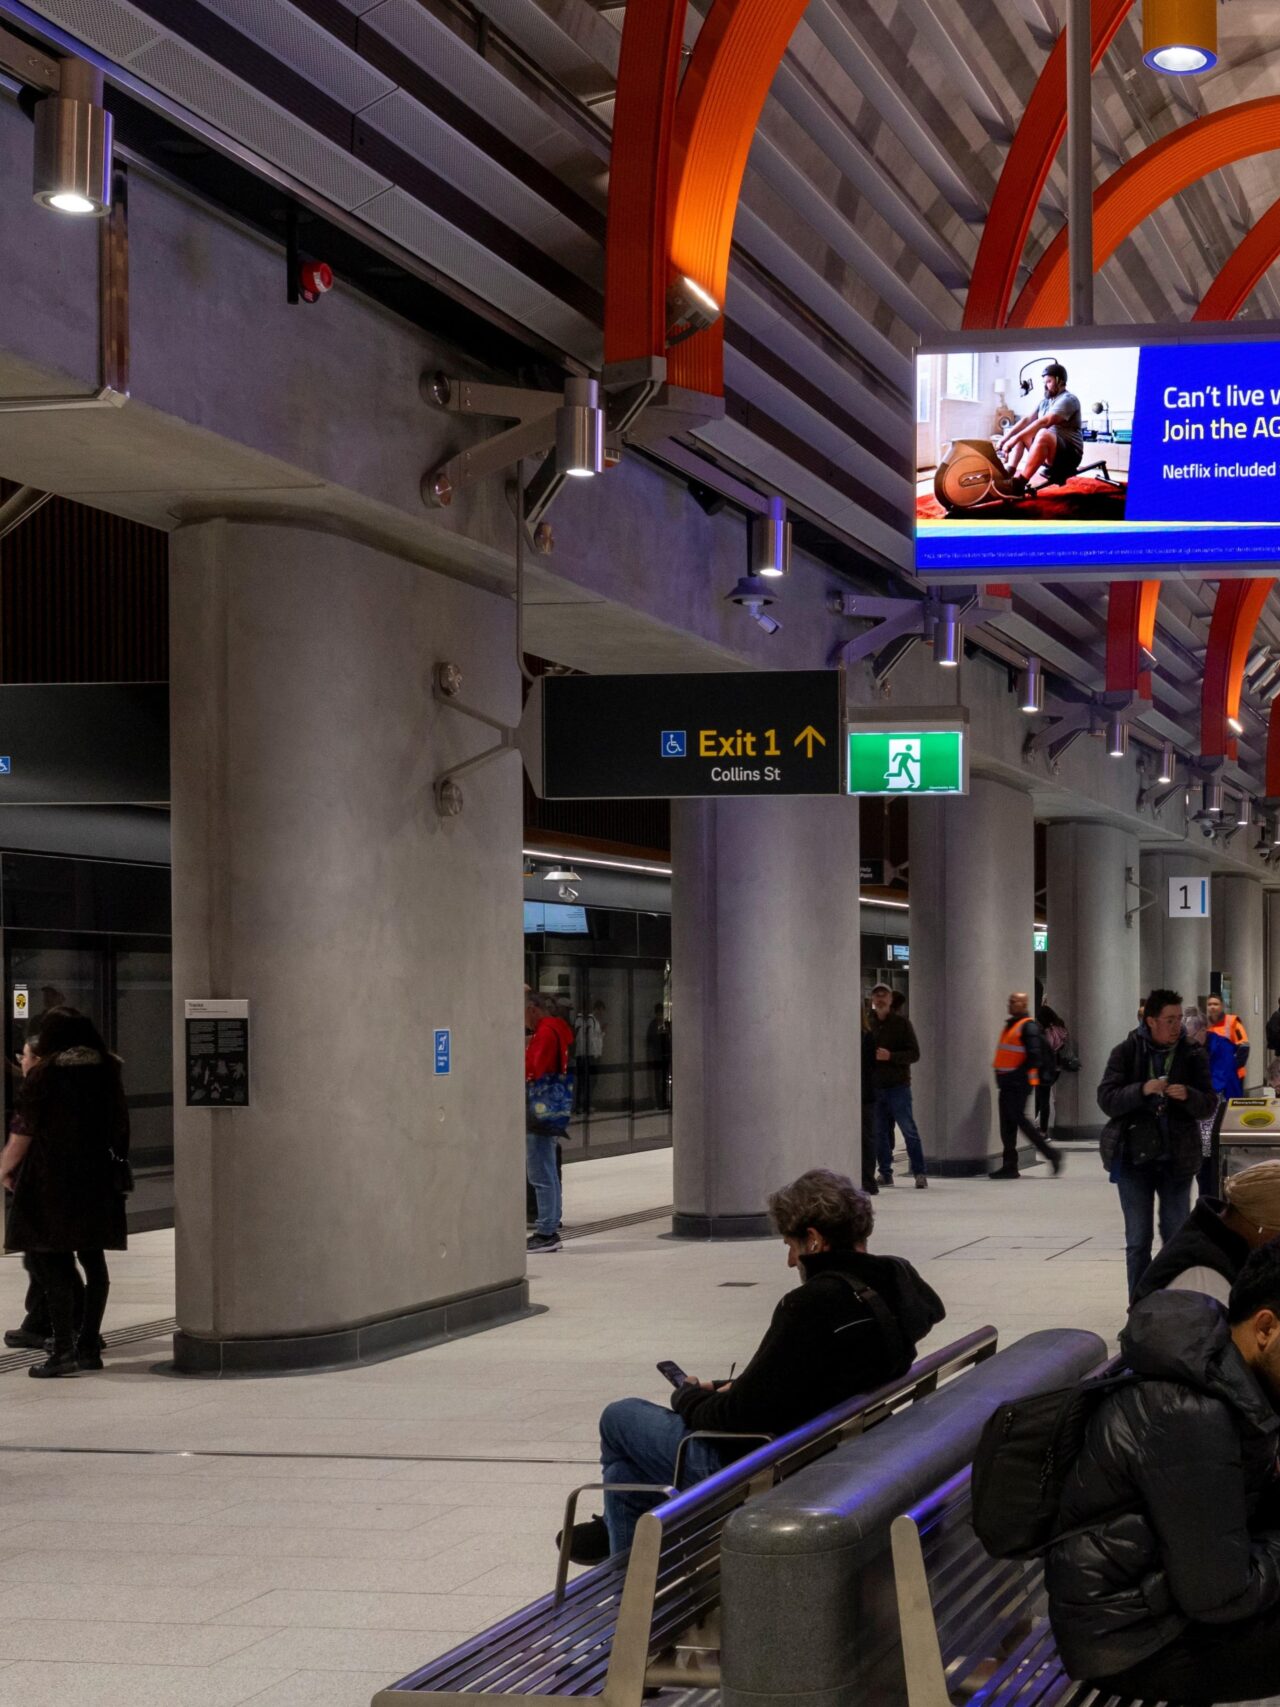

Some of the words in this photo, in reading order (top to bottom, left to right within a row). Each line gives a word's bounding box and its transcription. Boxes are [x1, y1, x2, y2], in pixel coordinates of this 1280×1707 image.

[1163, 386, 1221, 408] Can’t
[1226, 384, 1265, 407] live
[1162, 418, 1204, 442] Join
[1210, 417, 1247, 439] the
[1162, 463, 1211, 479] Netflix
[1214, 461, 1276, 478] included
[699, 728, 757, 757] Exit
[764, 728, 781, 756] 1
[711, 766, 760, 782] Collins
[764, 766, 781, 781] St
[1178, 885, 1191, 910] 1
